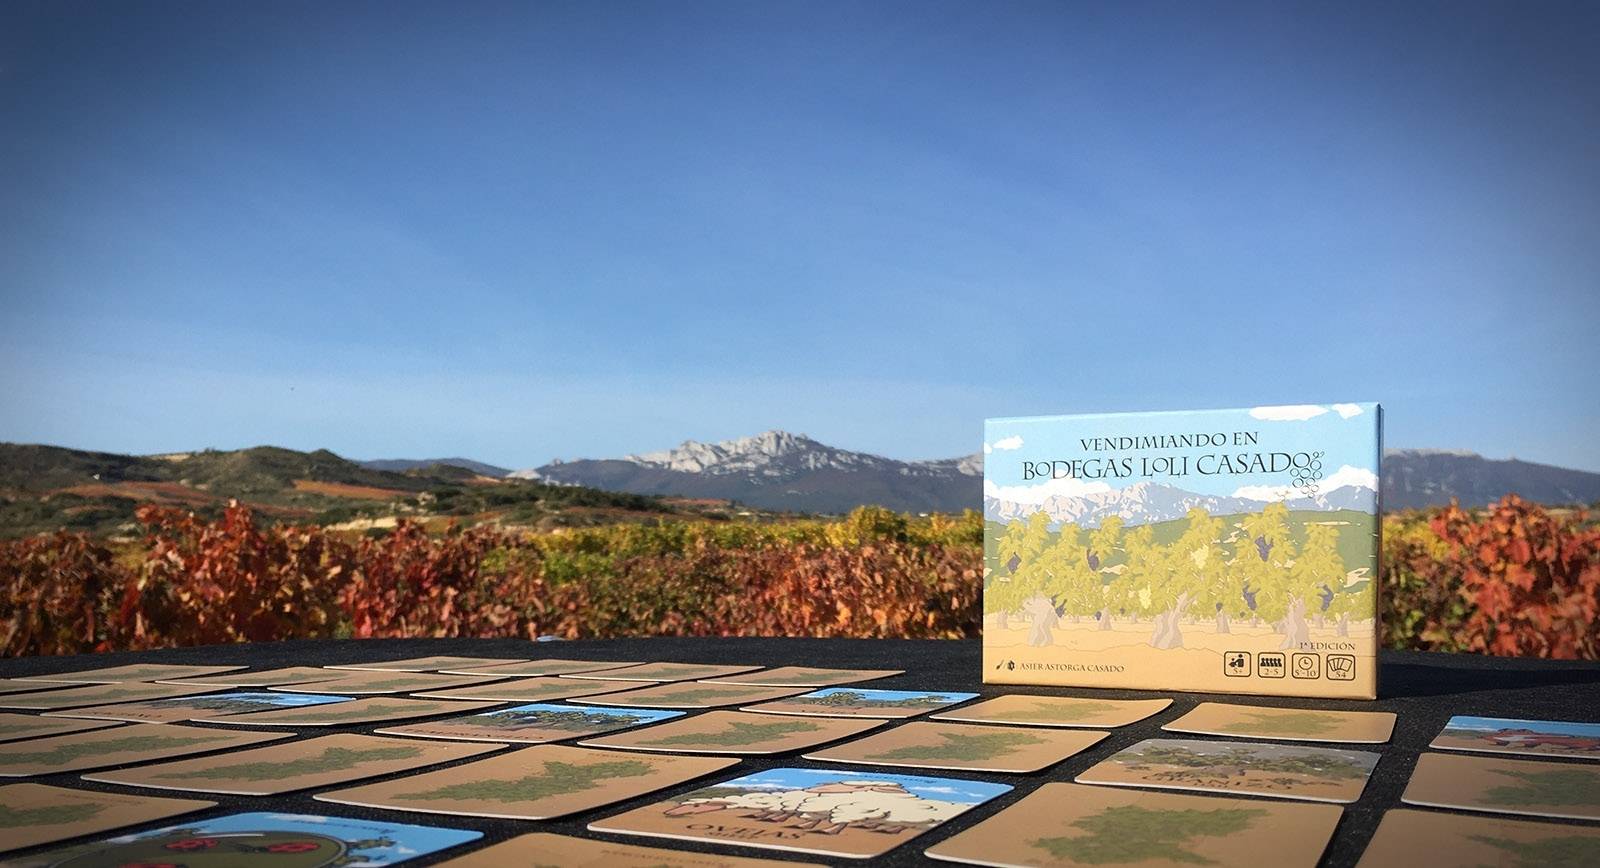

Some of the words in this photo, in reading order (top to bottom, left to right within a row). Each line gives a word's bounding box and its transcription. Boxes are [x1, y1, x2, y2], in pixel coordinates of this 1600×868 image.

[1080, 432, 1227, 452] VENDIMIANDO
[1233, 431, 1259, 446] EN
[1022, 457, 1133, 481] BODEGAS
[1141, 456, 1190, 478] LOLI
[1196, 452, 1312, 476] CASADO
[1310, 641, 1356, 651] EDICIÓN
[1019, 662, 1044, 671] ASIER
[1044, 663, 1087, 672] ASTORGA
[1087, 664, 1125, 673] CASADO
